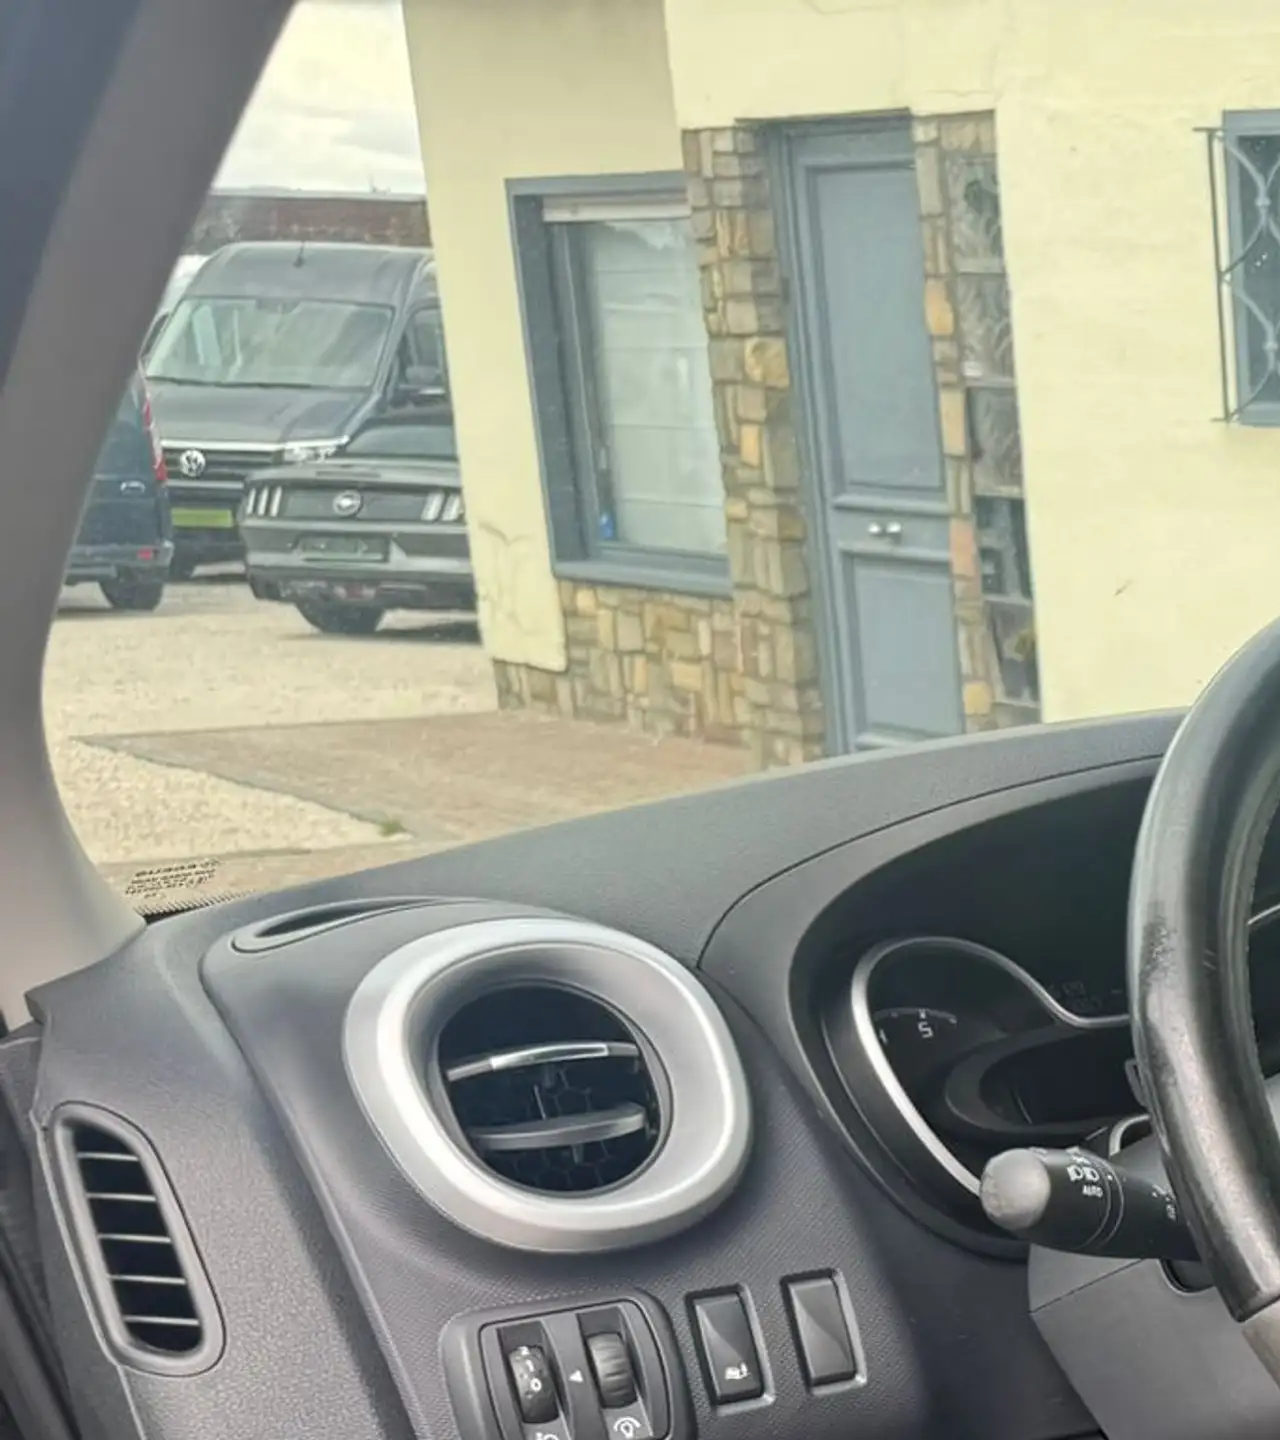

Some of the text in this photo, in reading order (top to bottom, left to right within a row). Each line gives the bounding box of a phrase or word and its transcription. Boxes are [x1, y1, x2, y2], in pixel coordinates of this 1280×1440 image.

[917, 1020, 934, 1039] 5
[1082, 1184, 1104, 1198] AUTO
[530, 1377, 542, 1392] 0
